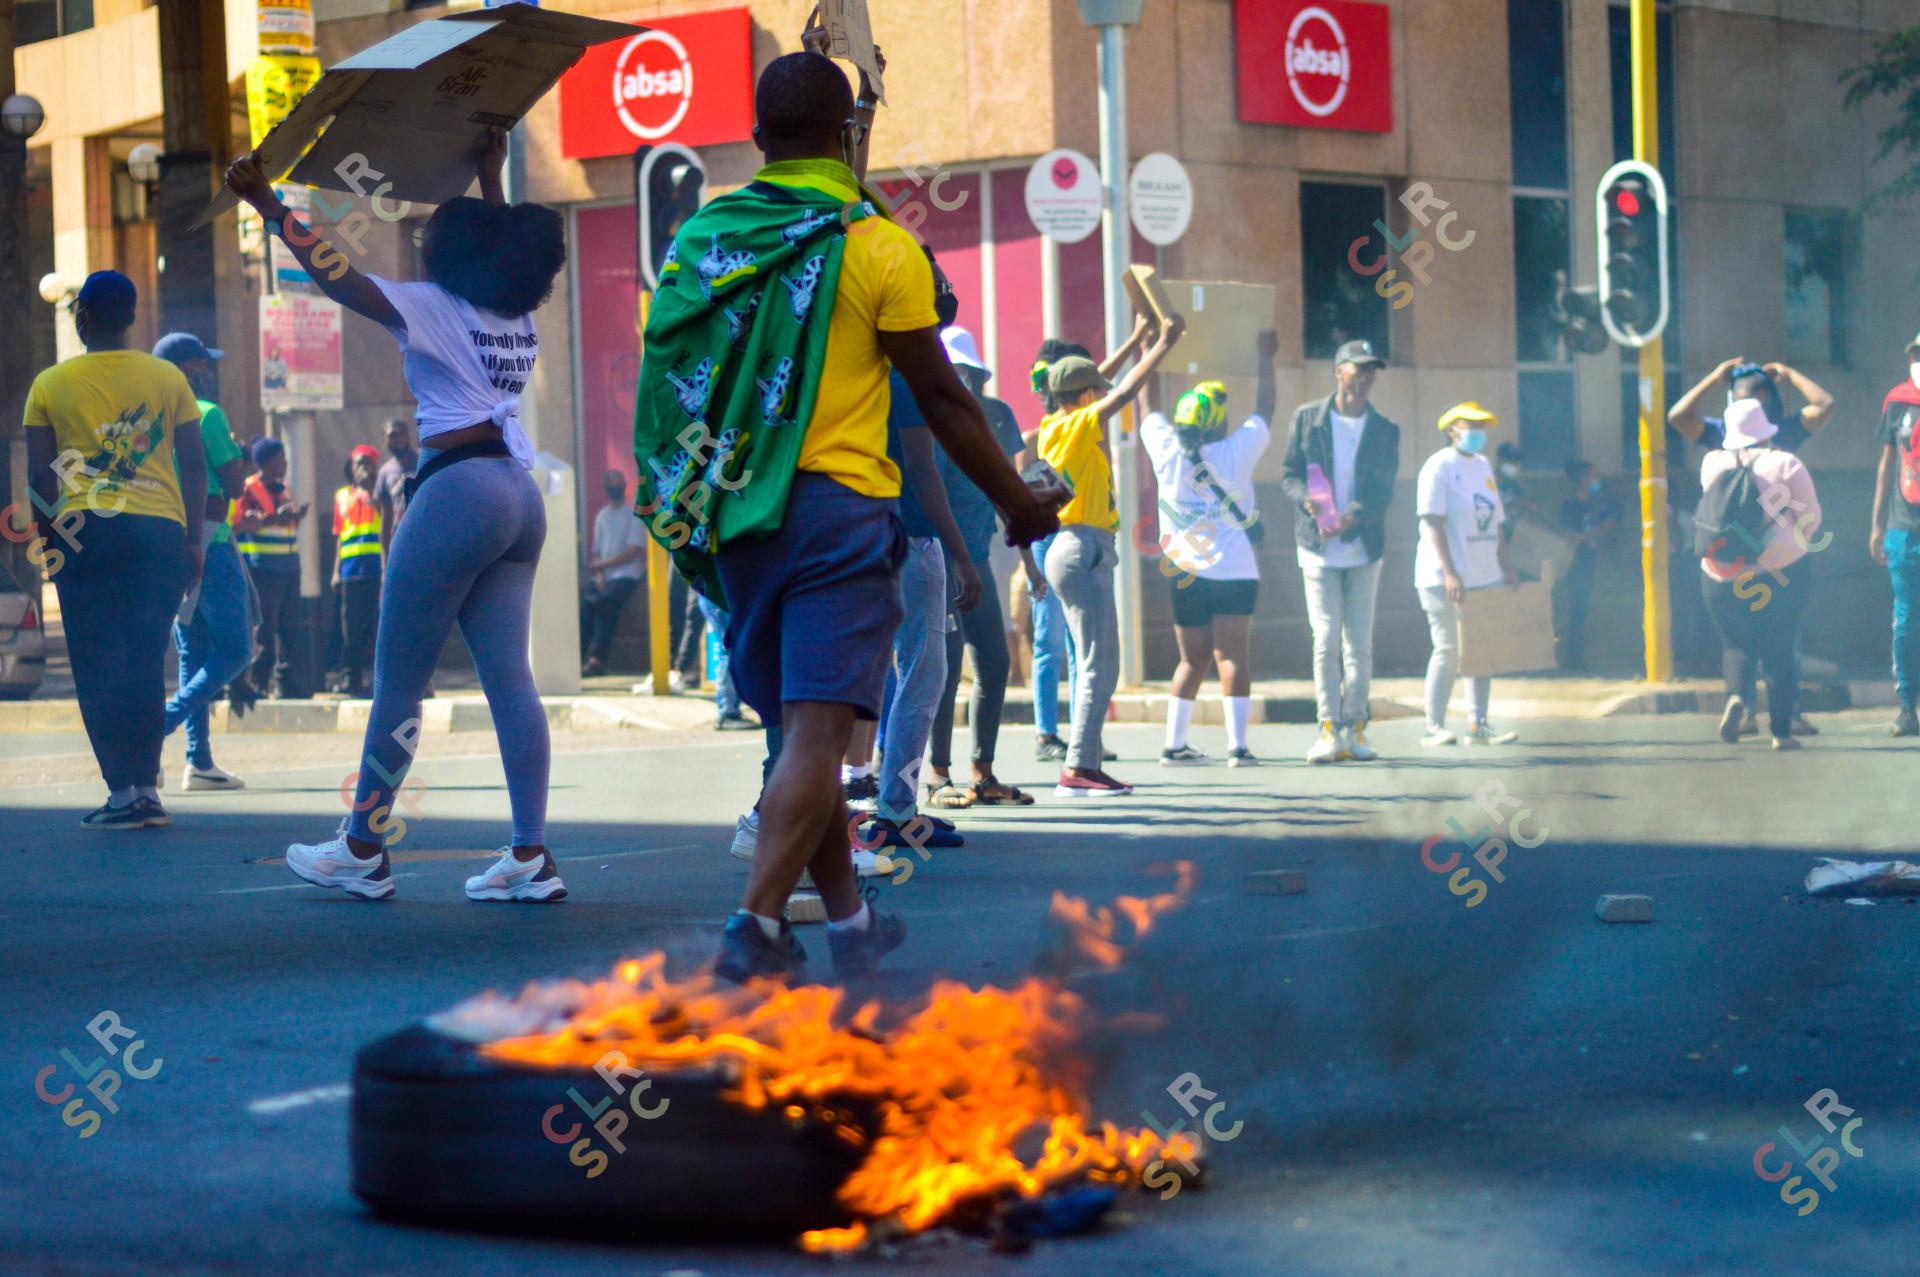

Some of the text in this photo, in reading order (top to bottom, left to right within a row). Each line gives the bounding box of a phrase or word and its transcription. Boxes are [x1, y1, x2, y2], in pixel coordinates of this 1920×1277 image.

[1294, 38, 1341, 76] absa
[436, 76, 480, 97] Bran
[624, 63, 683, 99] absa
[498, 357, 516, 372] you
